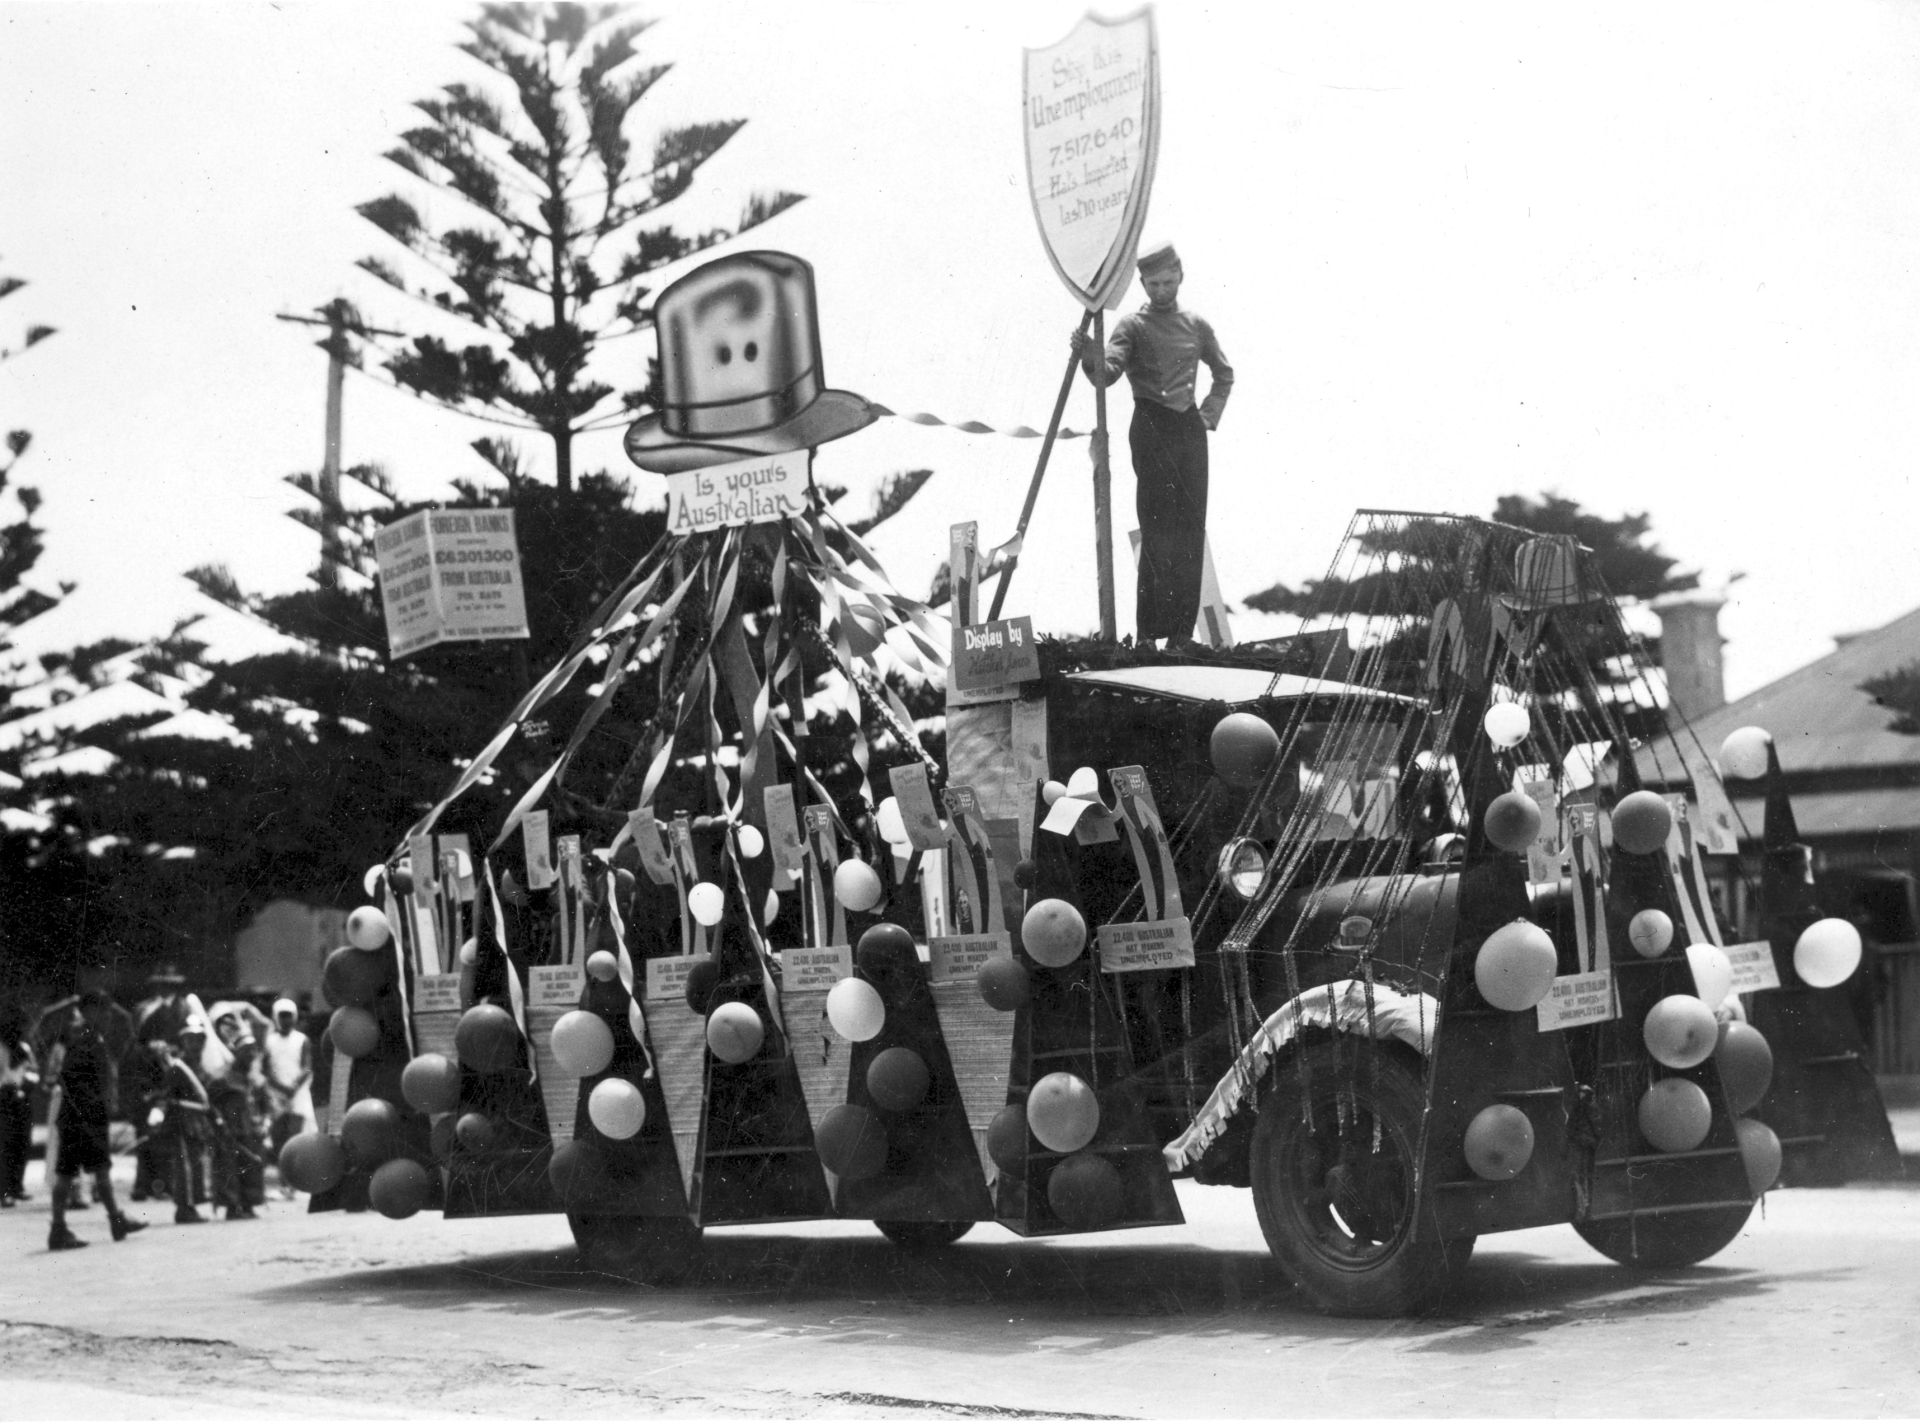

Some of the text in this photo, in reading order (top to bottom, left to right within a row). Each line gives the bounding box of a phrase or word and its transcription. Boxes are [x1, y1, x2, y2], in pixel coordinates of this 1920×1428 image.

[1031, 57, 1145, 128] Unemployment
[1059, 198, 1081, 226] last
[694, 473, 715, 497] Is
[674, 488, 801, 529] Australian
[964, 619, 1023, 652] Display by
[1137, 927, 1175, 941] AUSTRALIAN
[965, 941, 997, 952] AUSTRALIAN
[1120, 952, 1173, 964] UNEMPLOYED
[1559, 1005, 1607, 1020] UNEMPLOYED
